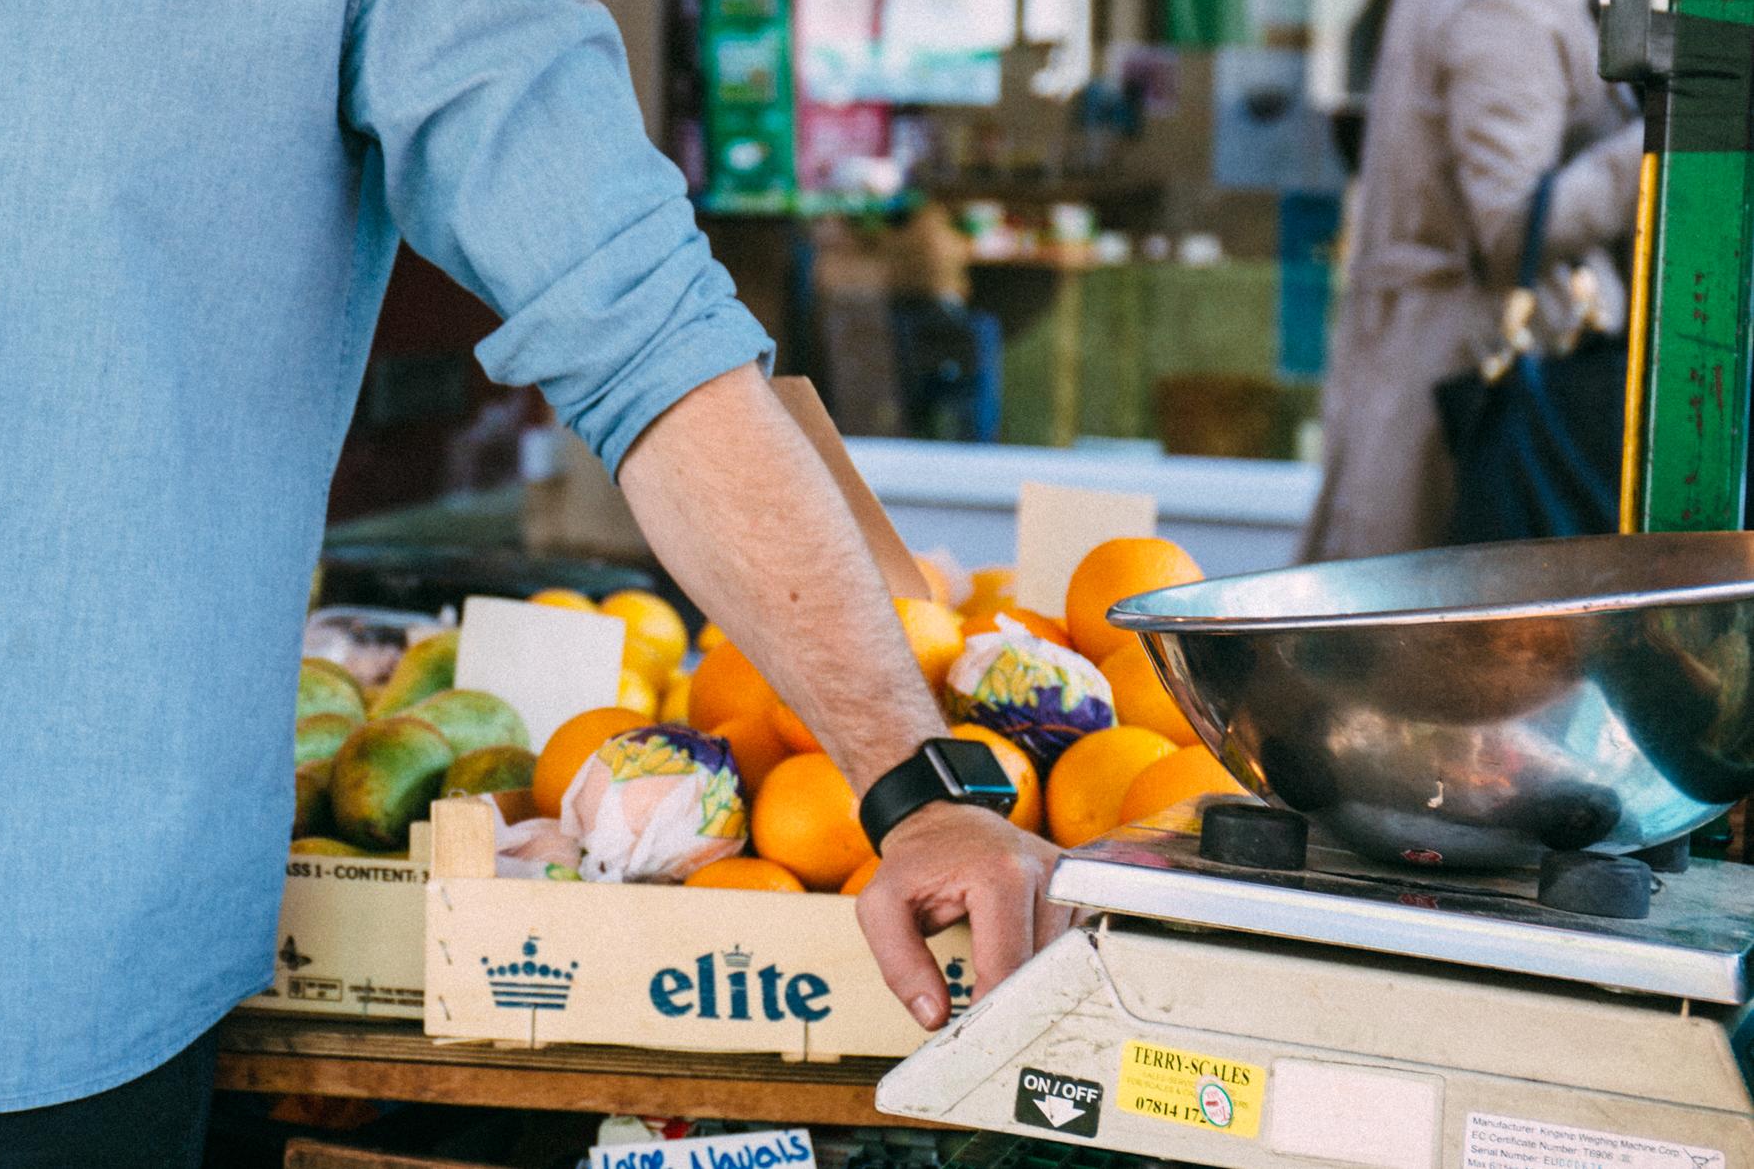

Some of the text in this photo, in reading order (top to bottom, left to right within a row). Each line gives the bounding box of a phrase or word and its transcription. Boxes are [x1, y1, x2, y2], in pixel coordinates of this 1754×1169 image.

[649, 947, 832, 1022] elite
[1133, 1045, 1251, 1086] TERRY-SCALES
[1023, 1074, 1099, 1104] ON/OFF
[1135, 1096, 1179, 1118] 07814
[1471, 1130, 1486, 1141] EC
[1489, 1133, 1537, 1149] Certificate
[1620, 1139, 1657, 1152] Machine
